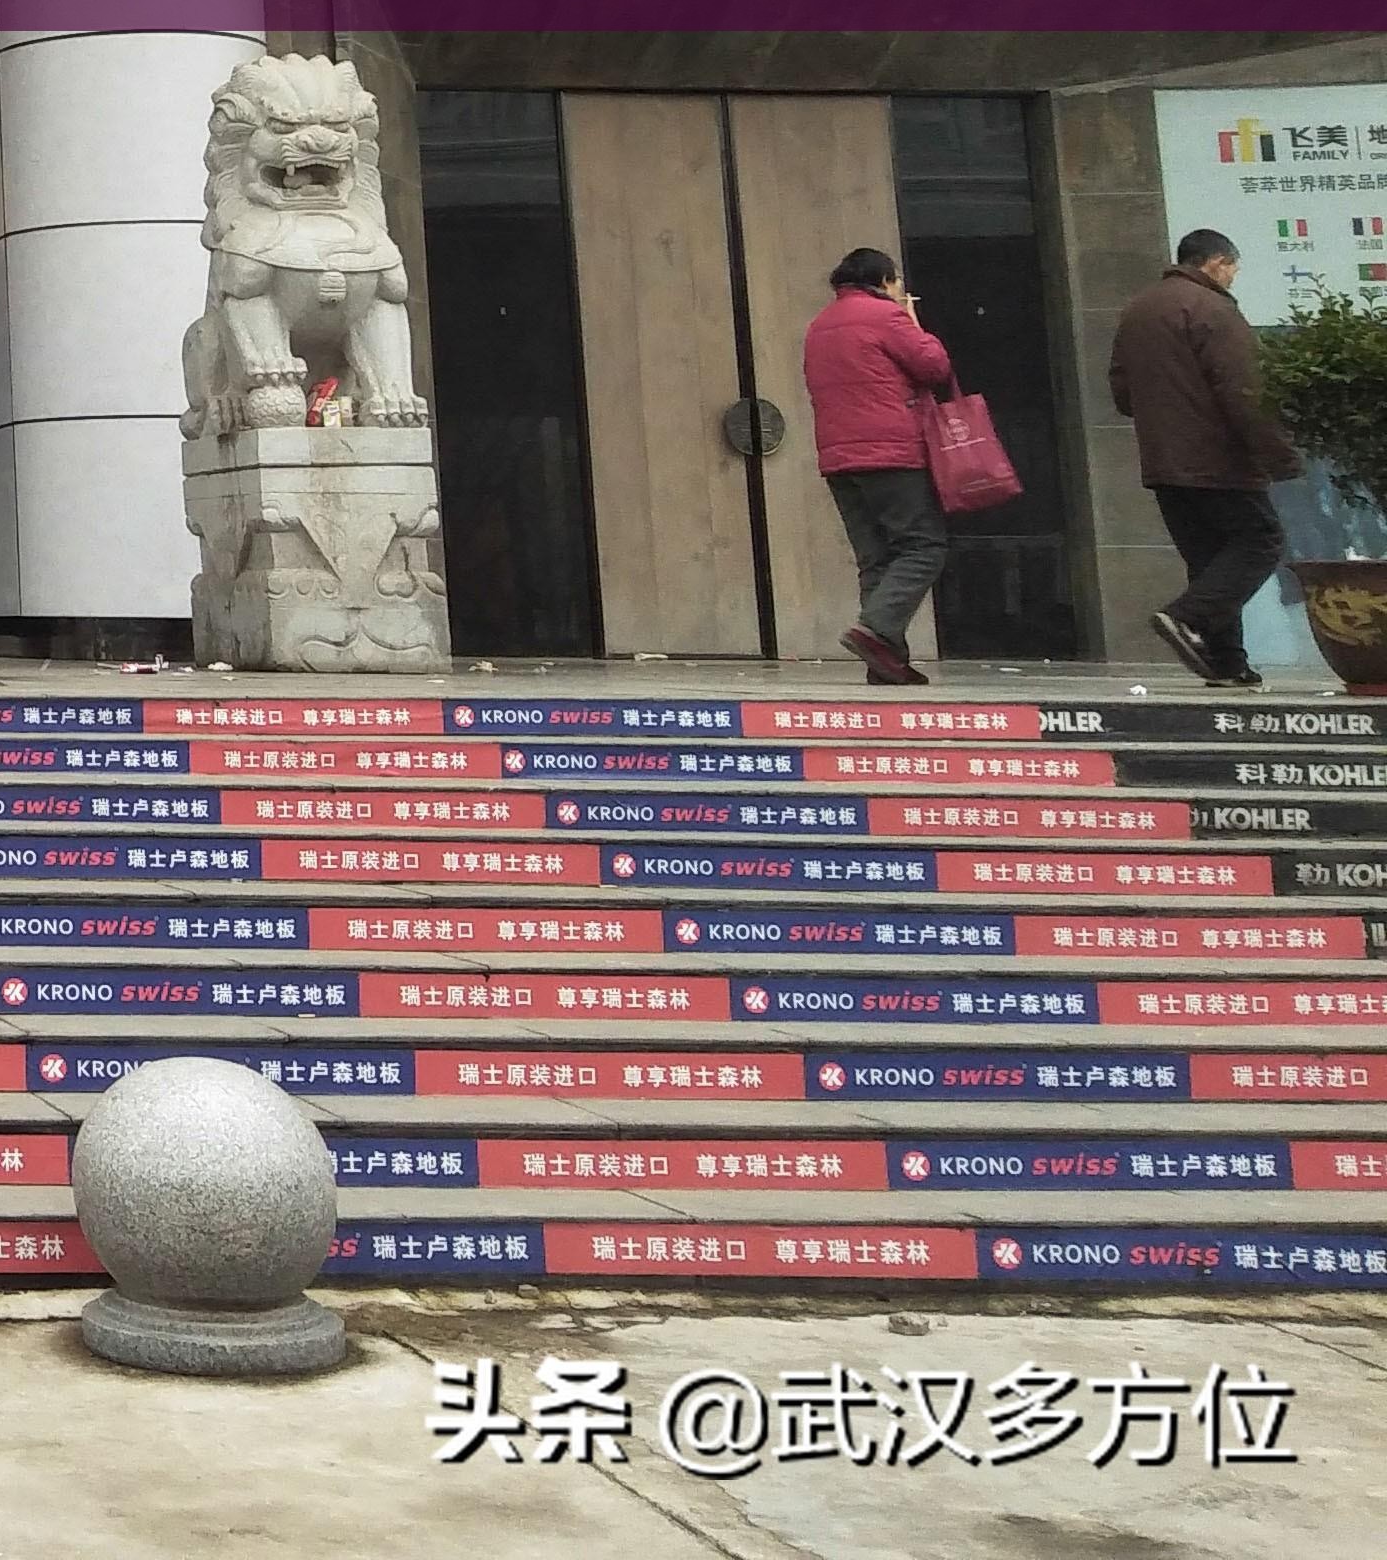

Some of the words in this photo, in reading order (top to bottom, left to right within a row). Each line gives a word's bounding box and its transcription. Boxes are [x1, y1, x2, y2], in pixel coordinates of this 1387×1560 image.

[1282, 125, 1349, 147] 飞美
[1292, 150, 1349, 162] FAMILY
[24, 707, 131, 725] 瑞士卢森地板
[176, 708, 283, 725] 瑞士原装进口
[303, 708, 410, 726] 尊享瑞士森林
[1284, 713, 1375, 736] KOHLER
[534, 755, 597, 768] KRONO
[604, 755, 668, 769] swiss
[680, 754, 792, 772] 瑞士卢森地板
[836, 756, 948, 774] 瑞士原装进口
[968, 759, 1080, 777] 尊享瑞士森林
[13, 798, 80, 815] swiss
[92, 798, 209, 817] 瑞士卢森地板
[256, 800, 371, 819] 瑞士原装进口
[394, 801, 510, 820] 尊享瑞士森林
[1214, 807, 1313, 831] KOHLER
[645, 859, 713, 875] KRONO
[721, 862, 791, 877] swiss
[803, 860, 925, 880] 瑞士卢森地板
[974, 863, 1093, 882] 瑞士原装进口
[1116, 865, 1236, 885] 尊享瑞士森林
[2, 919, 73, 934] KRONO
[82, 917, 155, 935] swiss
[168, 918, 296, 939] 瑞士卢森地板
[348, 919, 473, 940] 瑞士原装进口
[498, 920, 624, 941] 尊享瑞士森林
[778, 993, 853, 1009] KRONO
[863, 995, 939, 1011] swiss
[951, 993, 1085, 1014] 瑞士卢森地板
[1138, 993, 1269, 1015] 瑞士原装进口
[855, 1068, 934, 1085] KRONO
[944, 1070, 1023, 1085] swiss
[1037, 1066, 1176, 1087] 瑞士卢森地板
[1232, 1065, 1368, 1087] 瑞士原装进口
[523, 1153, 668, 1177] 瑞士原装进口
[696, 1153, 842, 1177] 尊享瑞士森林
[1033, 1244, 1120, 1264] KRONO
[1131, 1244, 1219, 1265] swiss
